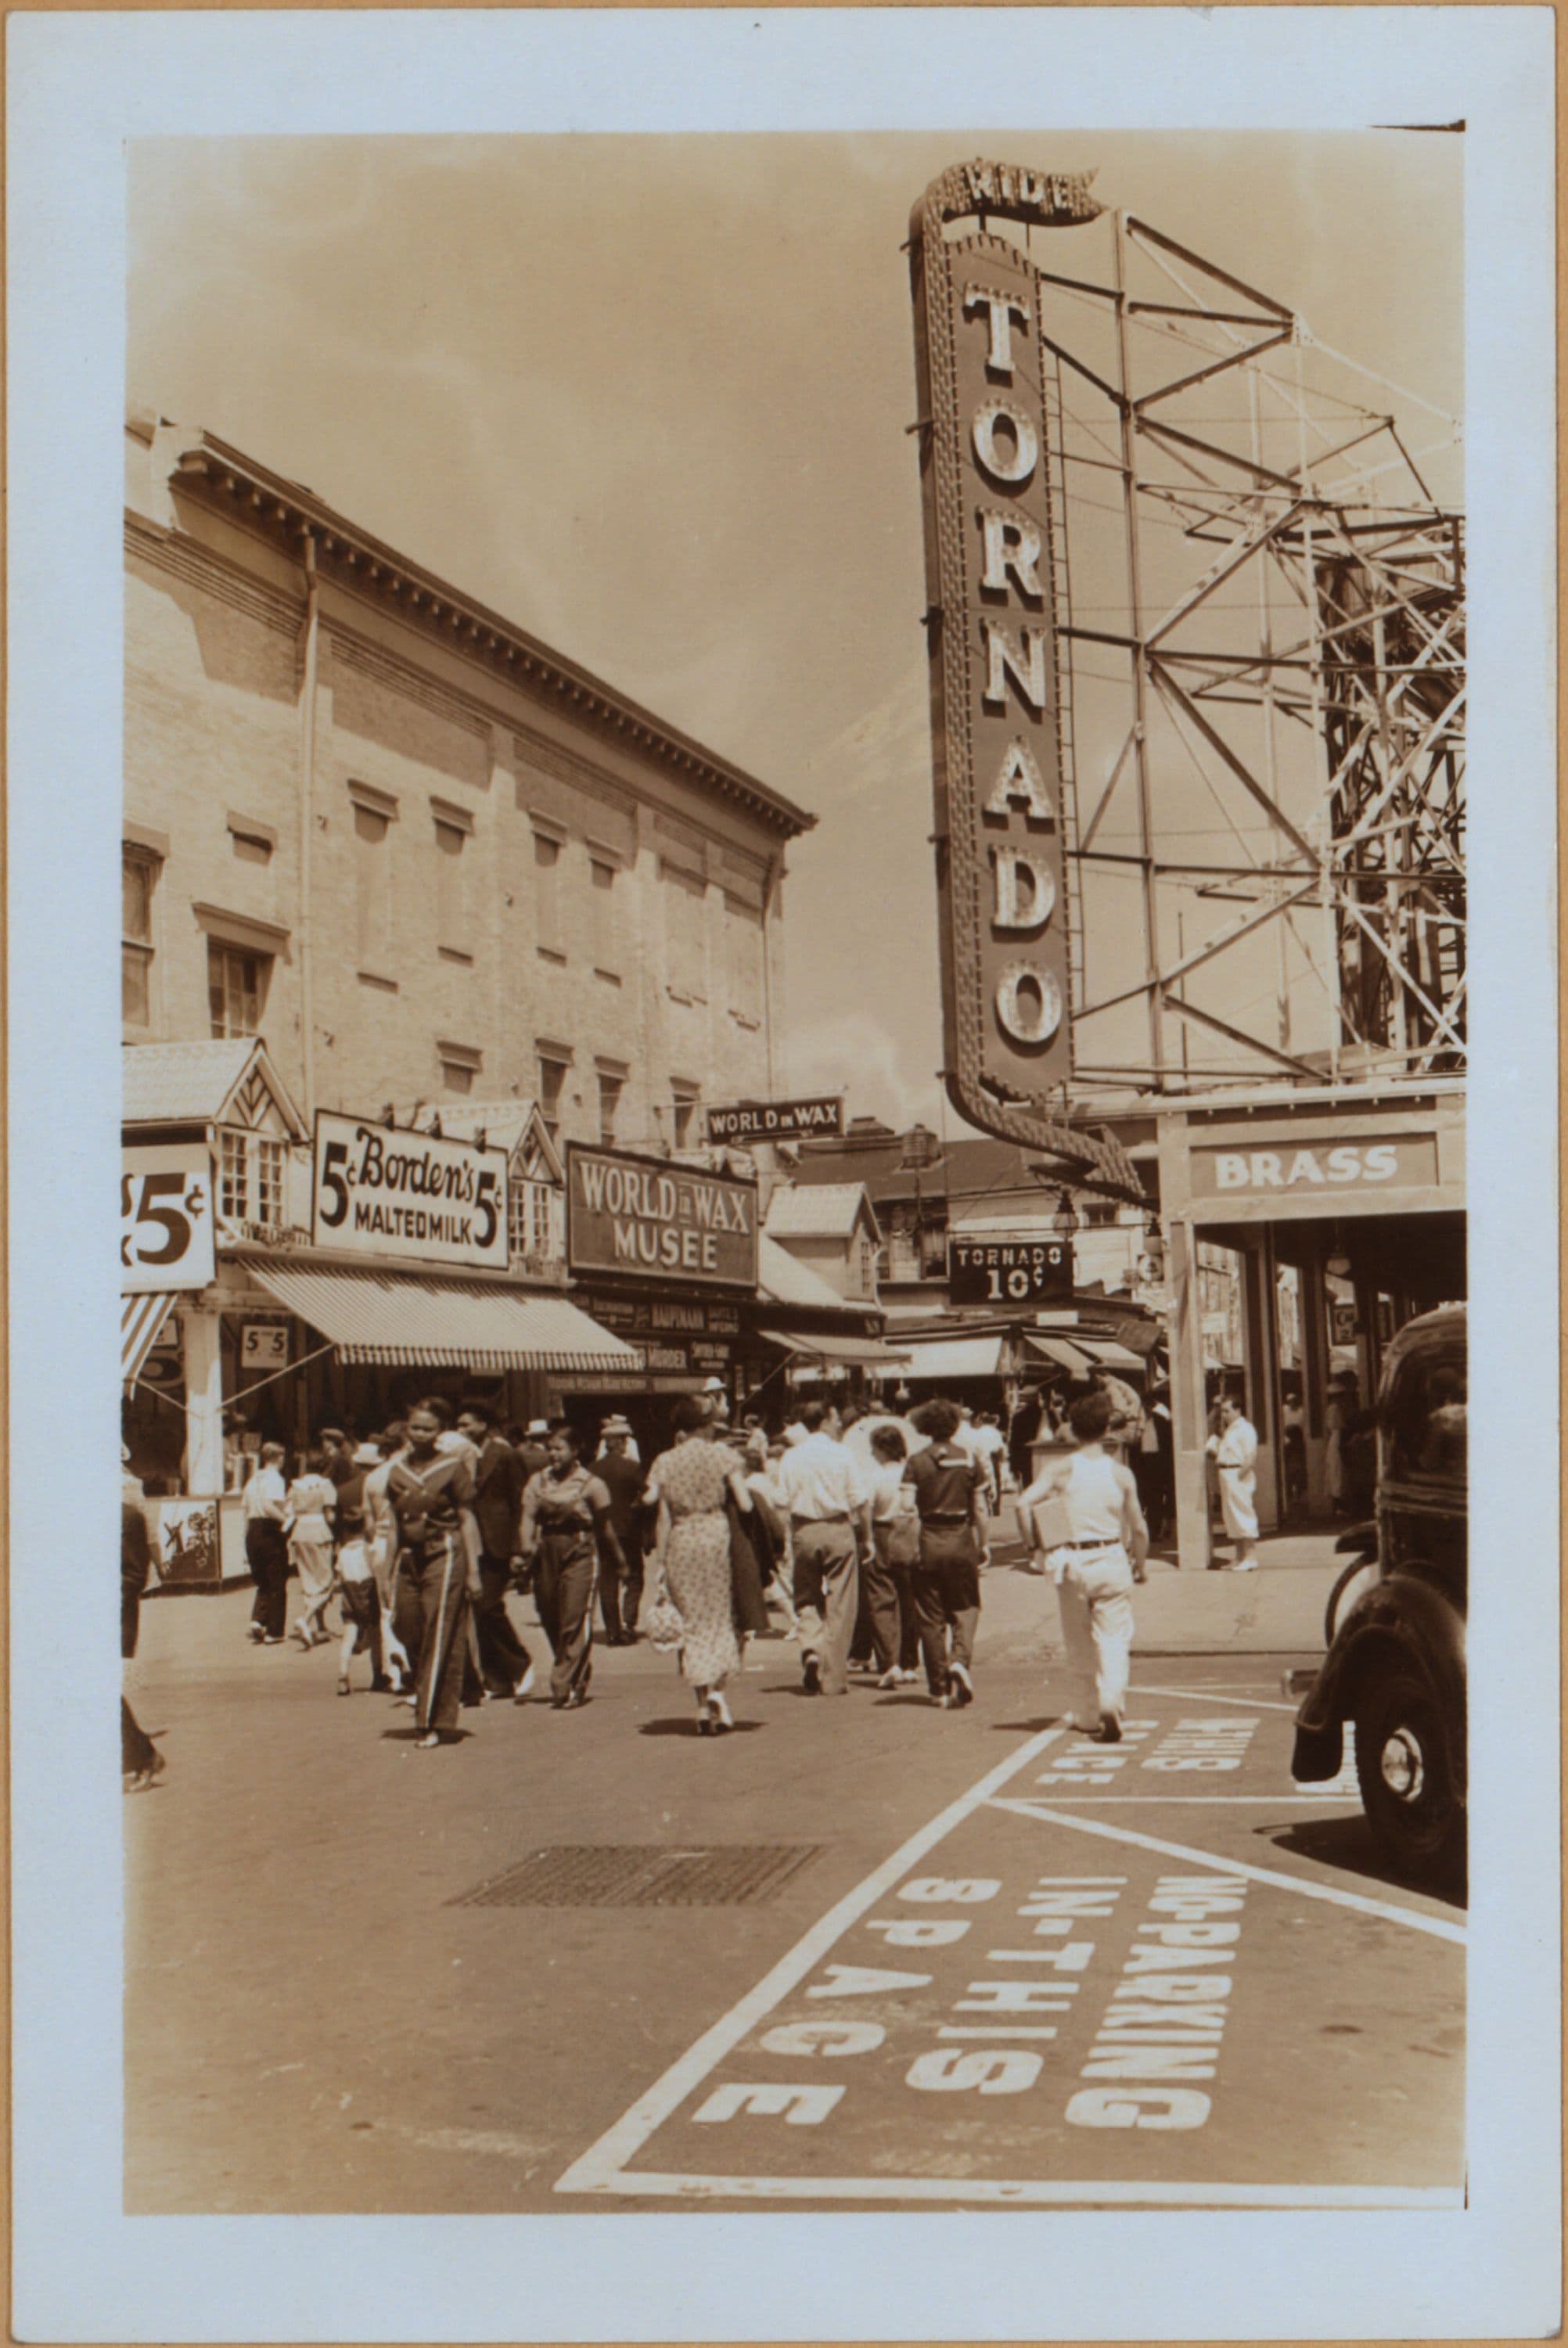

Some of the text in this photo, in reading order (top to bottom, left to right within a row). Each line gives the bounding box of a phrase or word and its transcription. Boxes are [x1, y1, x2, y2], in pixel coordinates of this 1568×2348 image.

[962, 162, 1072, 210] RIDE
[963, 280, 1063, 1042] TORNADO
[710, 1109, 778, 1134] WORLD
[794, 1103, 838, 1126] WAX
[356, 1127, 474, 1203] Borden's
[1214, 1145, 1398, 1189] BRASS
[135, 1172, 206, 1265] 5¢
[580, 1161, 678, 1221] WORLD
[692, 1185, 750, 1235] WAX
[354, 1201, 472, 1246] MALTED MILK
[613, 1220, 717, 1270] MUSEE
[957, 1246, 1062, 1267] TORNADO
[987, 1265, 1044, 1300] 10¢
